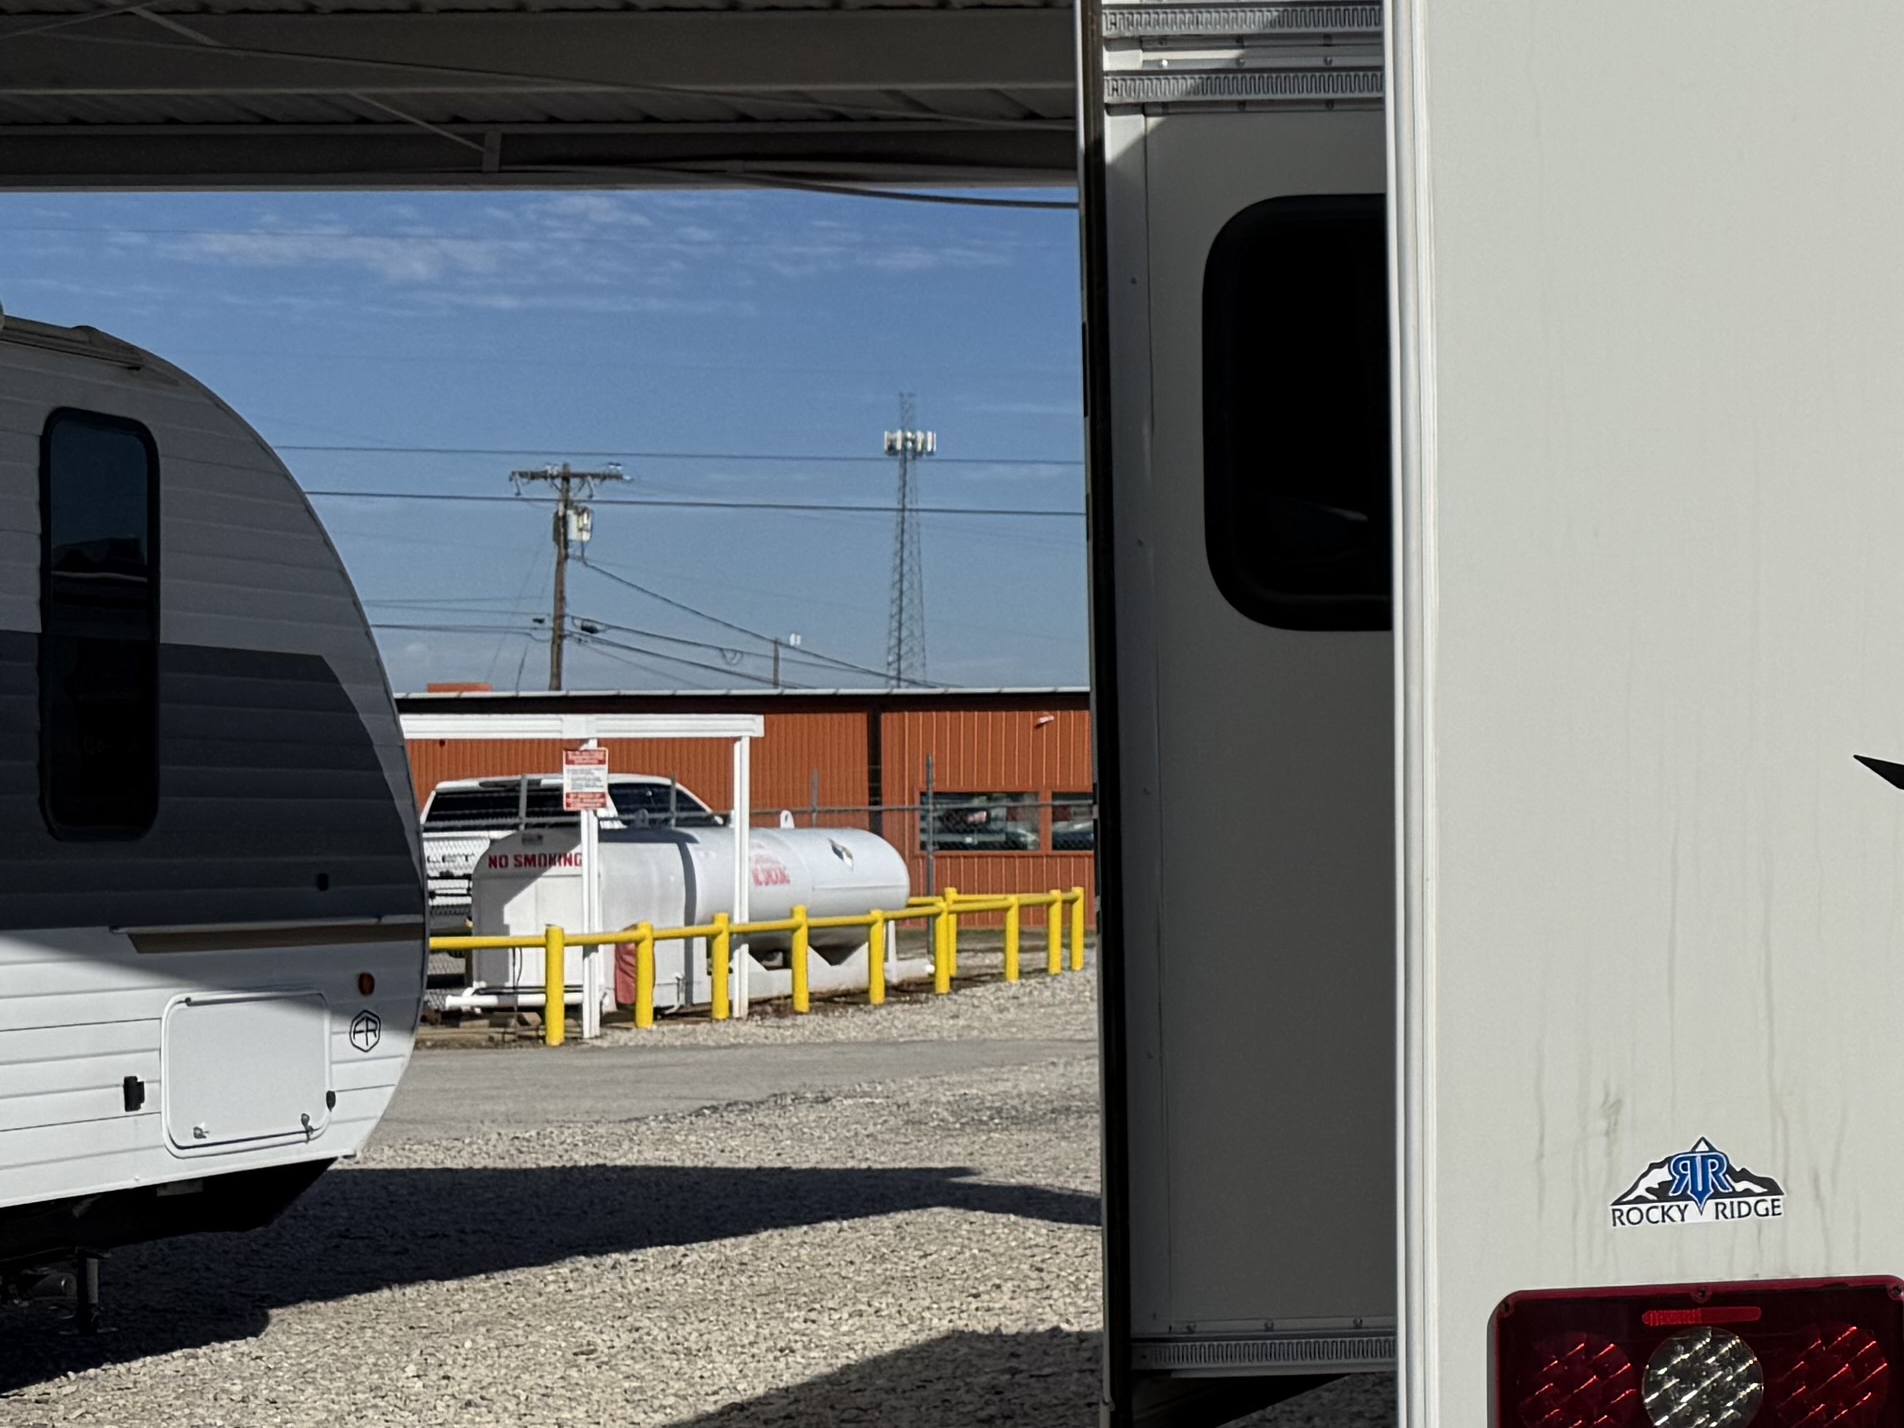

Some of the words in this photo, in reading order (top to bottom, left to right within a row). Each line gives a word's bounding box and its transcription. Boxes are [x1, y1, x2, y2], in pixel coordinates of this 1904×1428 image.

[488, 854, 509, 869] NO
[513, 852, 583, 869] SMOKING
[1611, 1203, 1689, 1227] ROCKY
[1714, 1198, 1783, 1221] RIDGE
